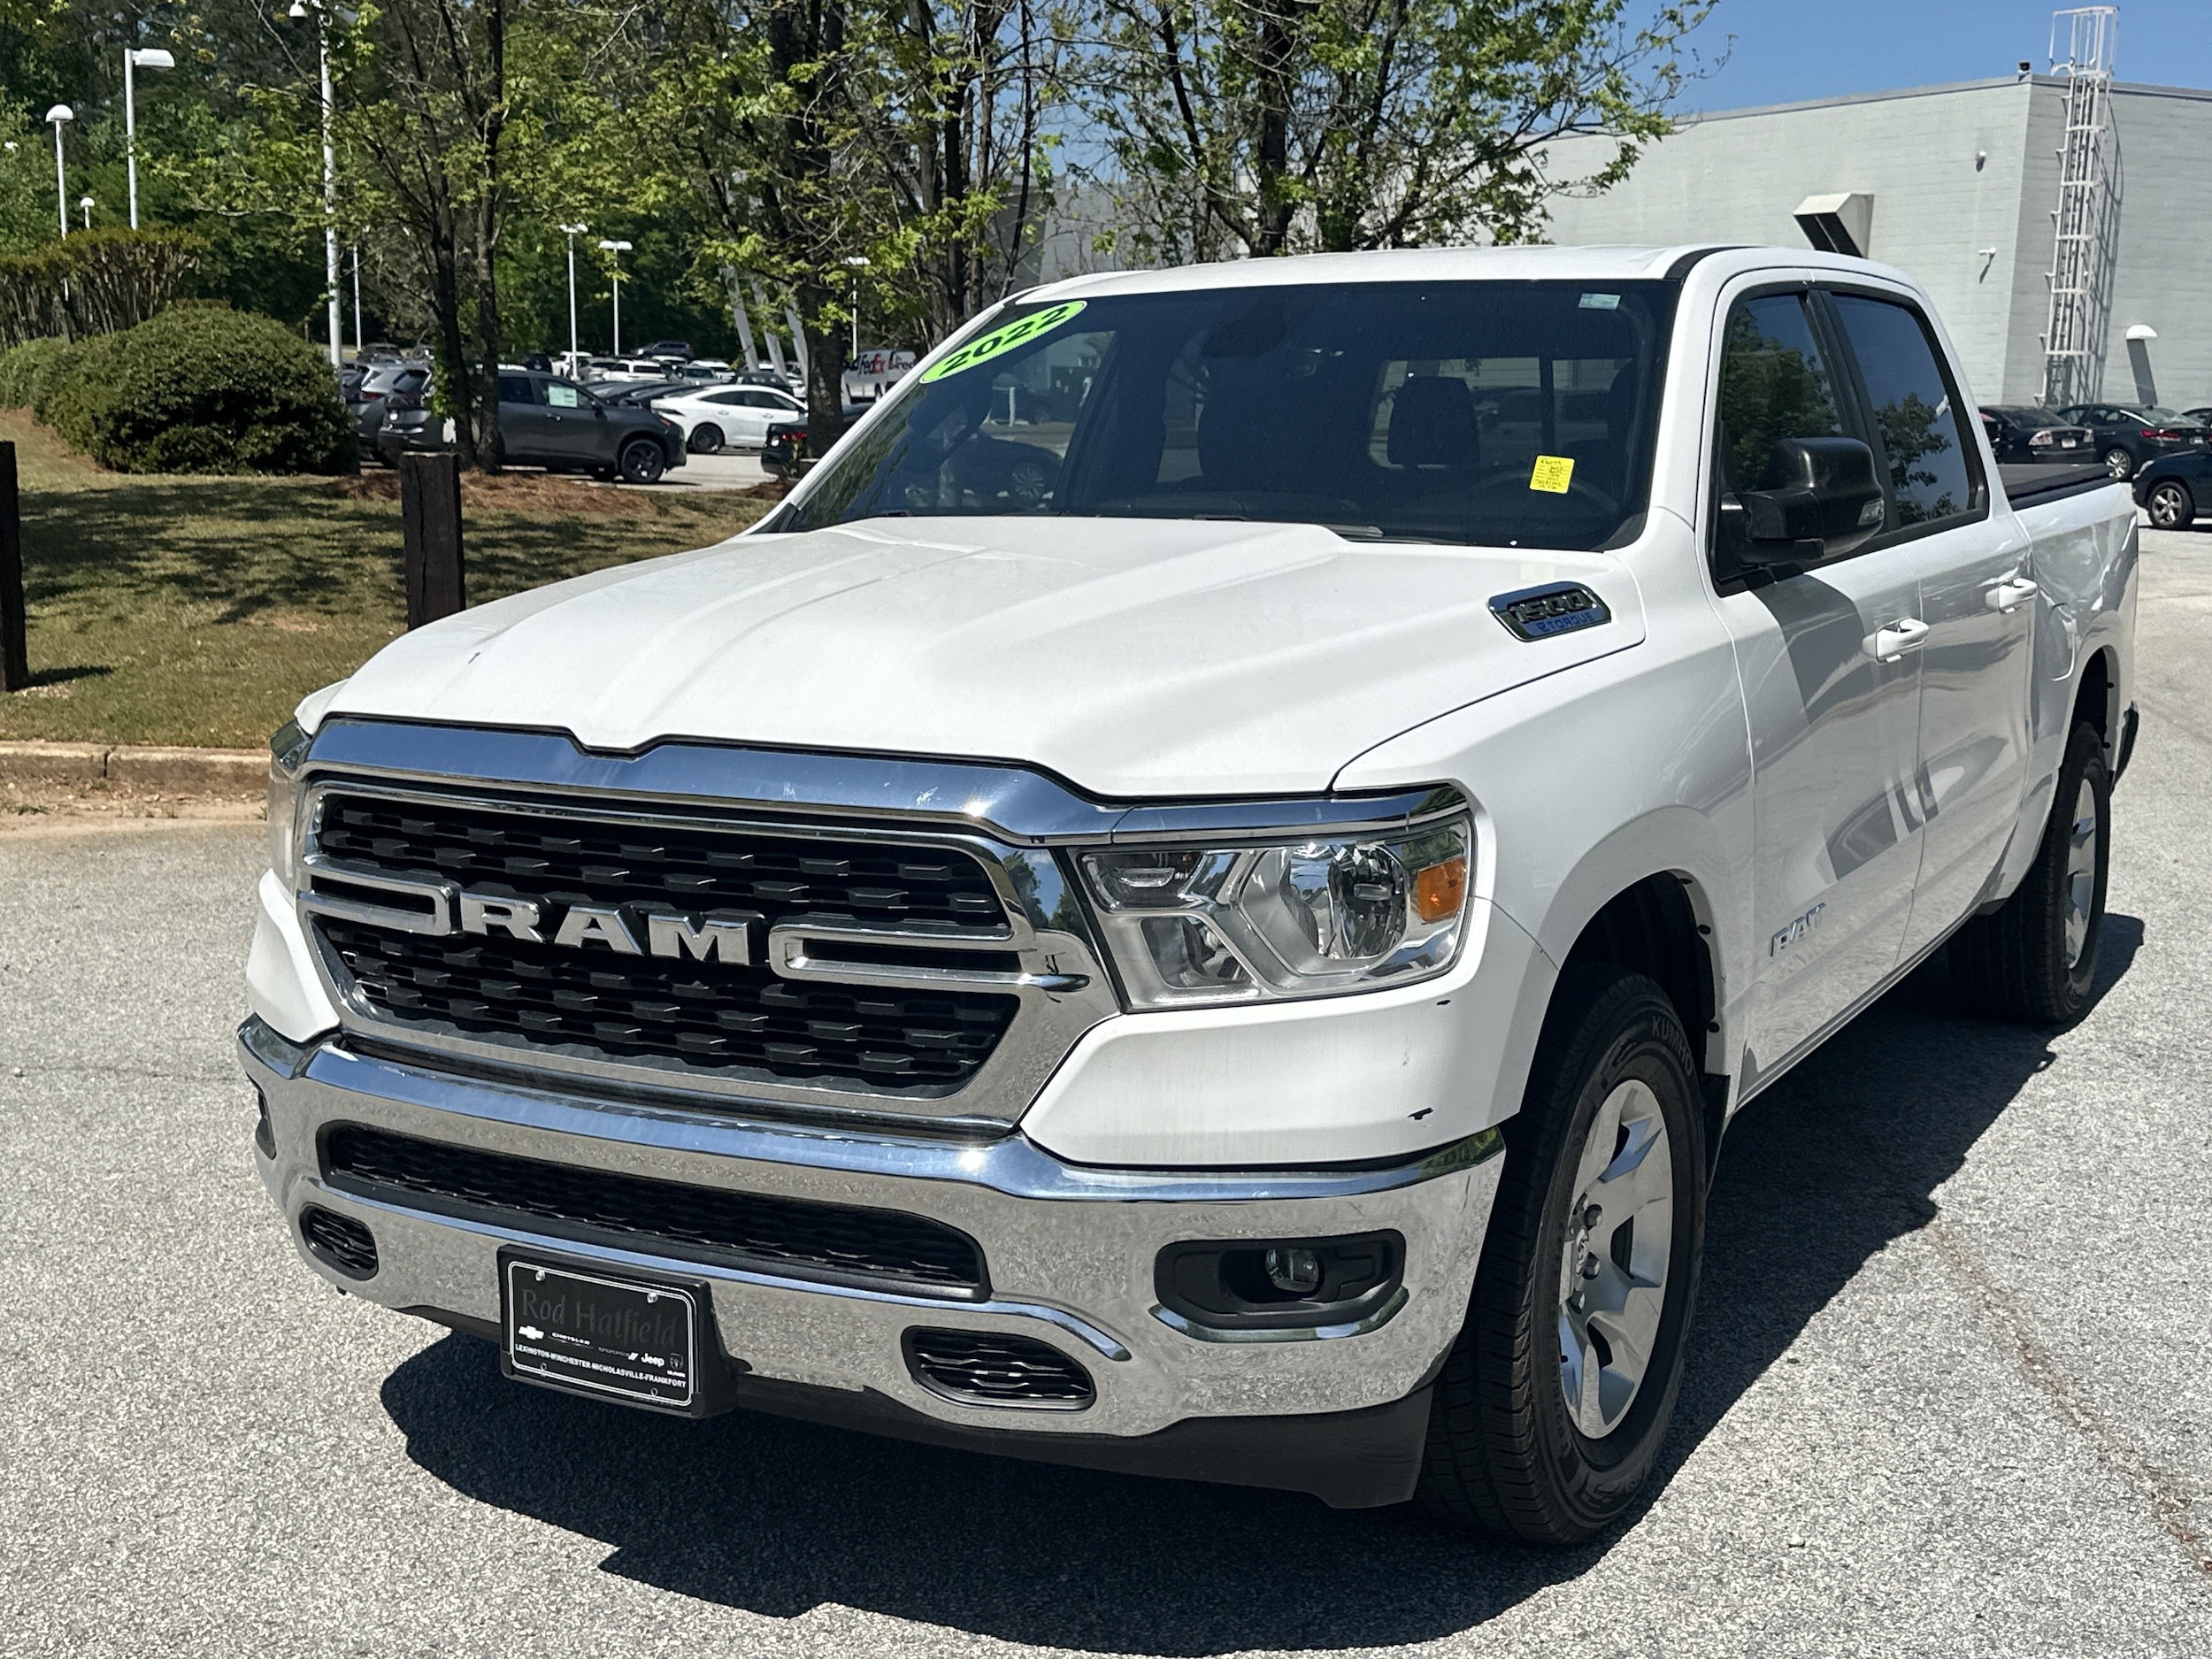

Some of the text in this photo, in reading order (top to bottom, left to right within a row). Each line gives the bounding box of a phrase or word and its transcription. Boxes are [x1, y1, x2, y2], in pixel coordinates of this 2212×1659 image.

[939, 306, 1070, 377] 2022
[1509, 590, 1591, 624] 1500
[459, 890, 750, 966] RAM
[1770, 902, 1826, 956] RAM
[1651, 1015, 1694, 1076] KUMHO
[522, 1288, 678, 1348] Rod Hatfield
[641, 1352, 664, 1367] Jeep
